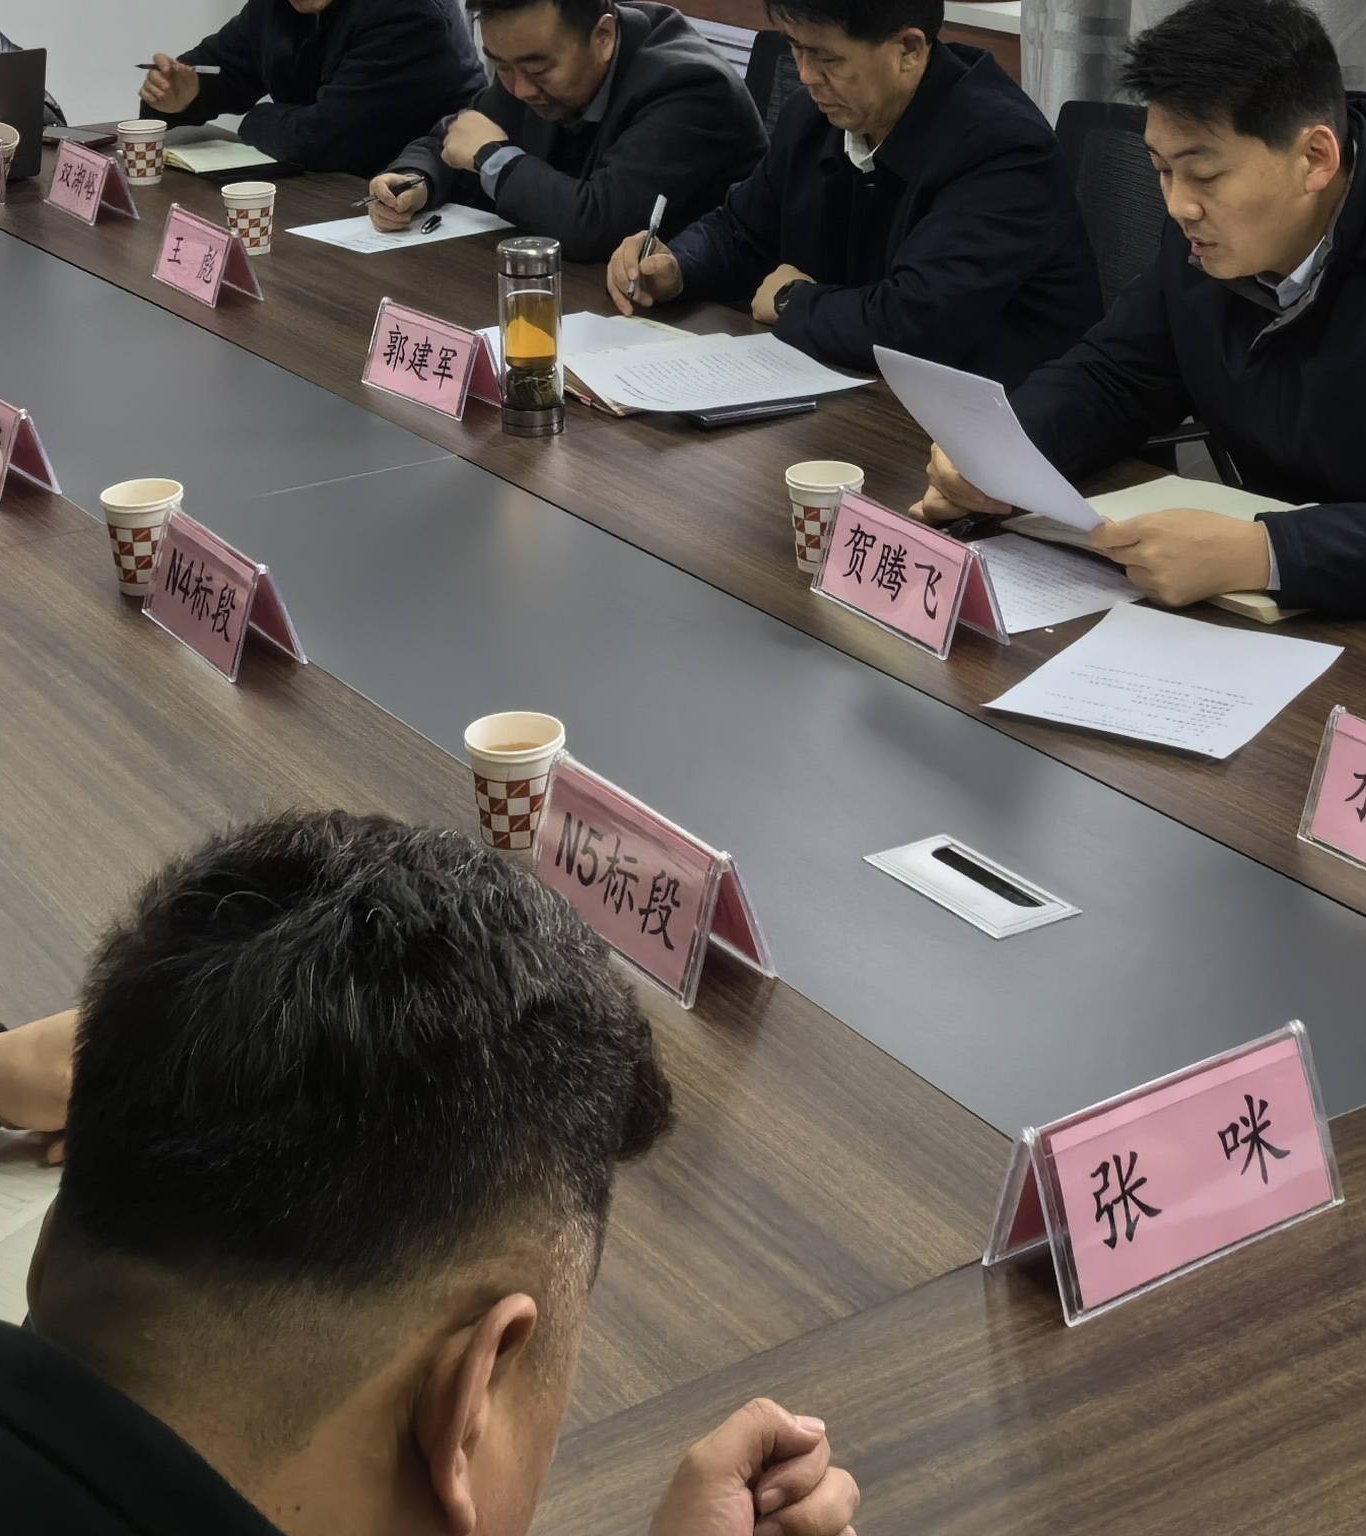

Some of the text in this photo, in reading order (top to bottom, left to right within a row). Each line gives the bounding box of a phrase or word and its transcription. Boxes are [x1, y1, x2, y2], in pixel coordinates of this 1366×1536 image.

[383, 324, 457, 391] 郭建军
[165, 547, 240, 644] N4标段
[842, 523, 943, 621] 贺腾飞
[554, 810, 683, 952] N5标段
